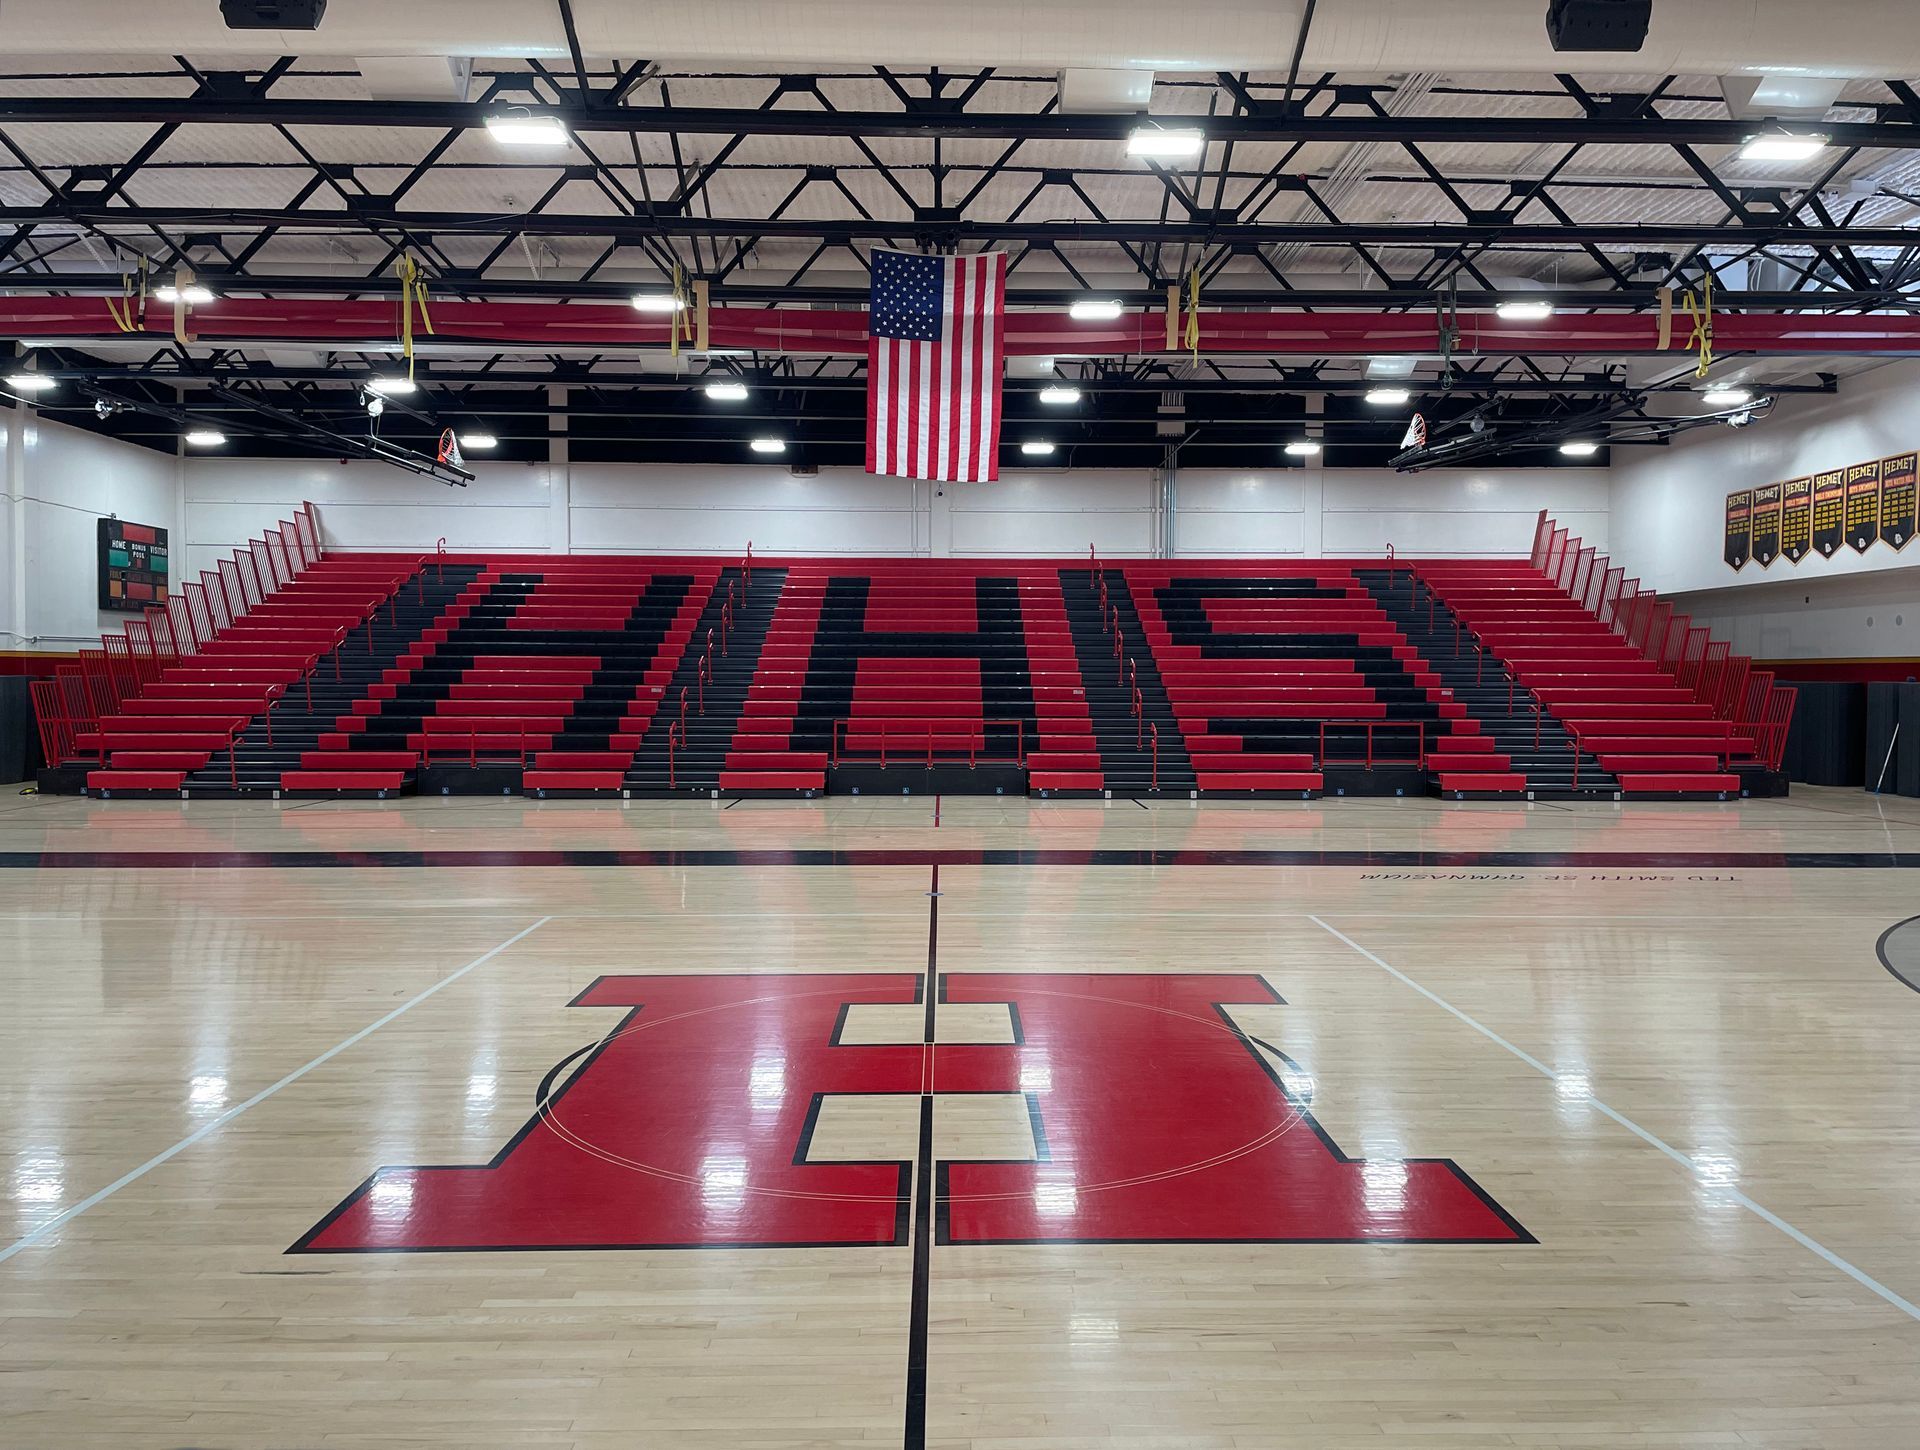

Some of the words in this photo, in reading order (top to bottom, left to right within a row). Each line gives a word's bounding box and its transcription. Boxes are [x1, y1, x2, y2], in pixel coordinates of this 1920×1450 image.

[1849, 464, 1878, 482] HEMET
[1885, 457, 1915, 476] HEMET
[1785, 479, 1810, 497] HEMET
[1816, 472, 1843, 490] HEMET
[1727, 493, 1750, 508] HEMET
[1755, 486, 1779, 502] HEMET
[112, 540, 126, 550] HOME
[132, 543, 146, 551] BONUS
[150, 546, 168, 555] VISITOR
[284, 973, 1538, 1255] H
